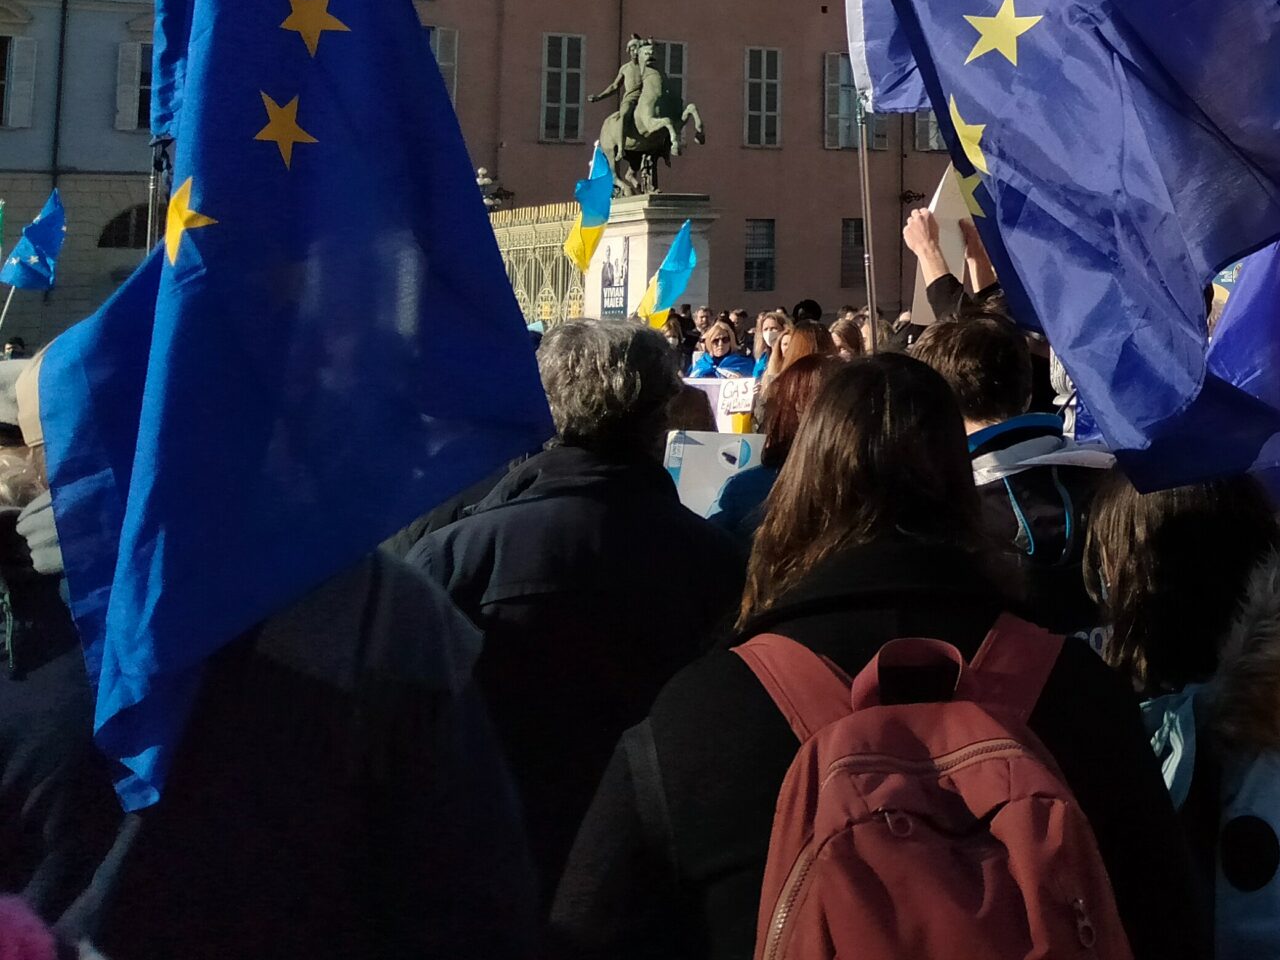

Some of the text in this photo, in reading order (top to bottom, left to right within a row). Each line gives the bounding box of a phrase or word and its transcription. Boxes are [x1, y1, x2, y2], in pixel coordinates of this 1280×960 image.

[603, 287, 624, 298] VIVIAN
[603, 297, 624, 308] MAIER
[722, 380, 749, 399] GAS
